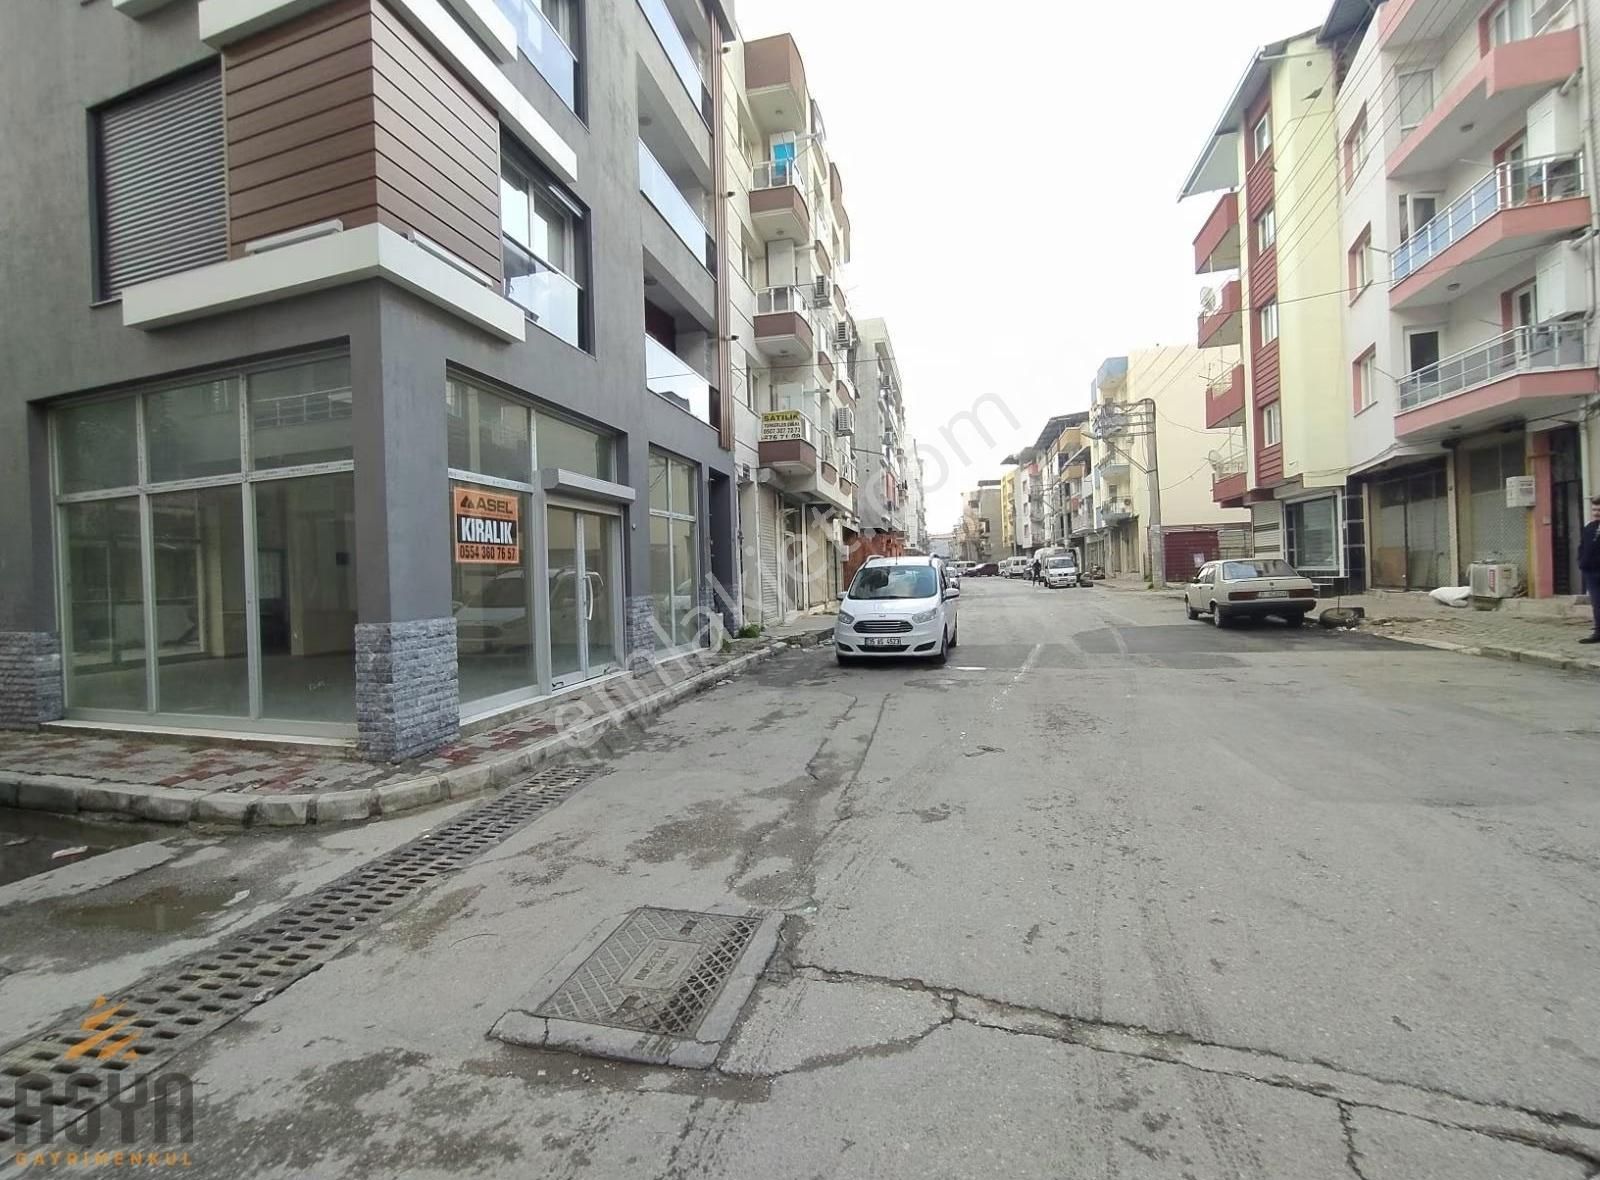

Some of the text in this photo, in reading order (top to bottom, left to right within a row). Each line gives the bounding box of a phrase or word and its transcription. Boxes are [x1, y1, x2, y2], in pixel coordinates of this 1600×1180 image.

[476, 497, 513, 514] ASEL
[459, 545, 516, 560] 0554 360 76 57
